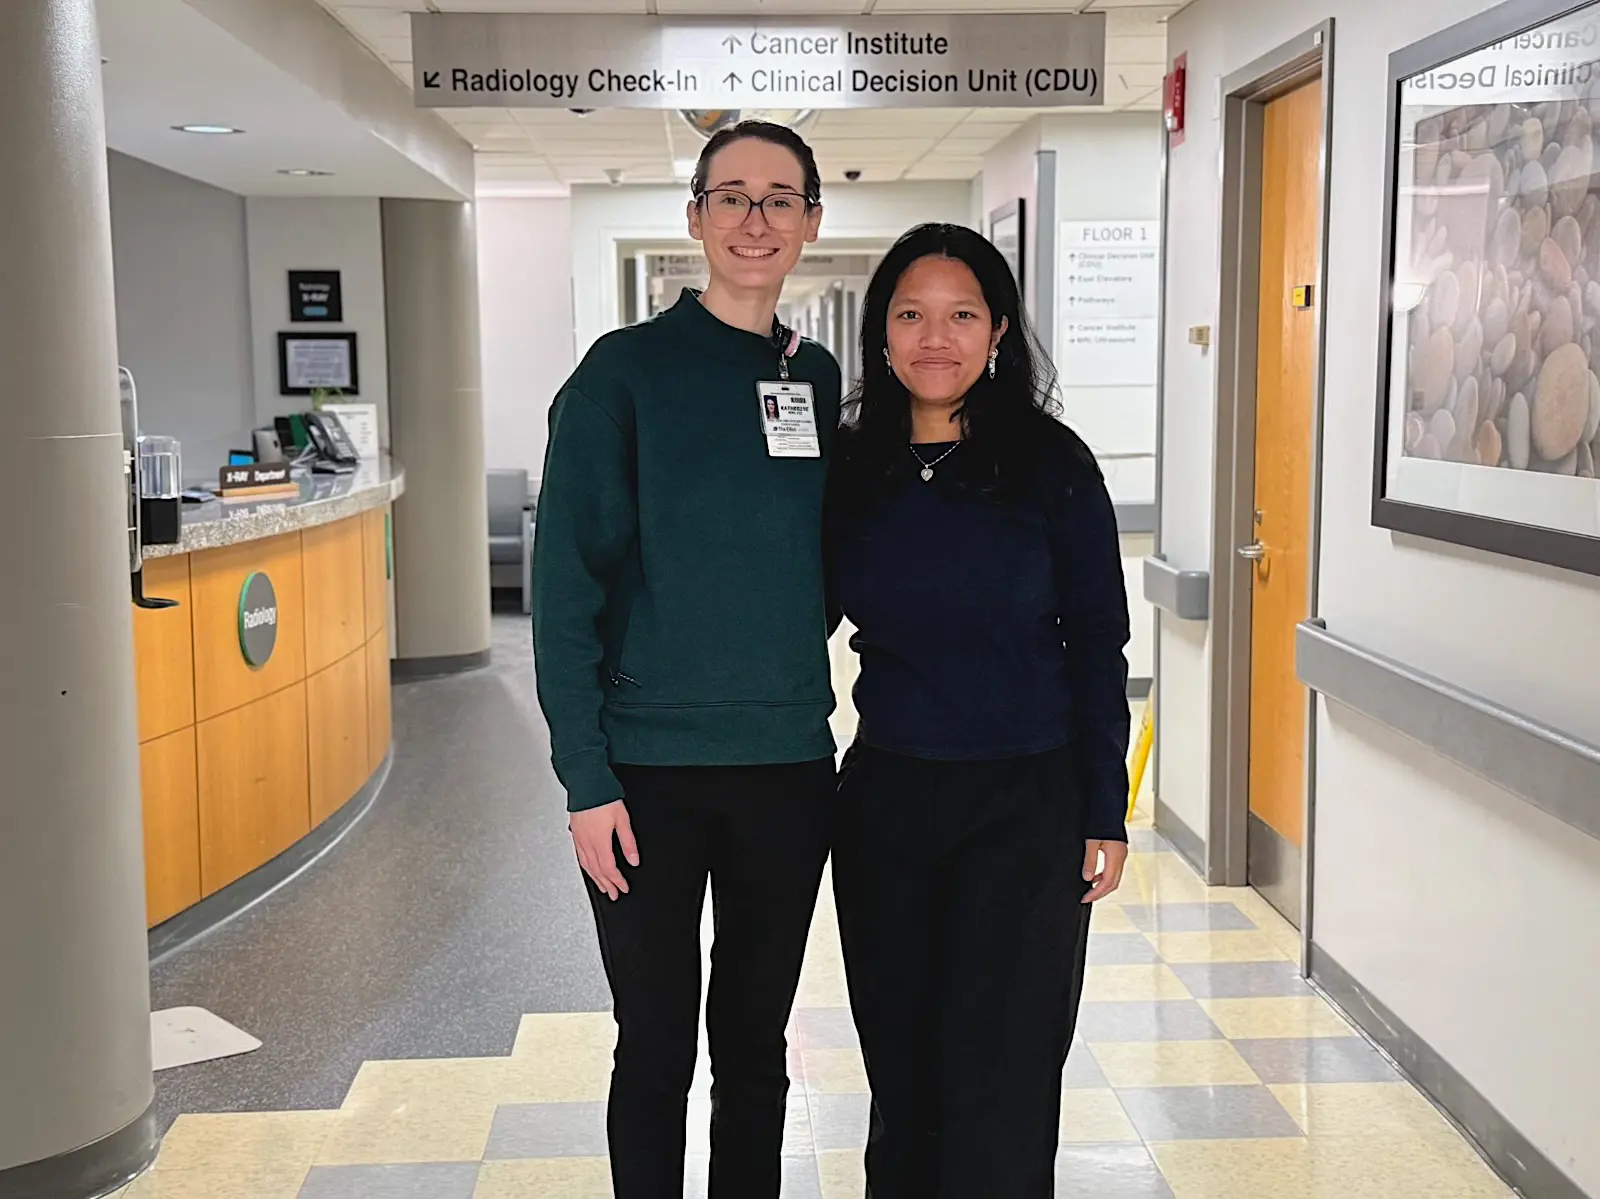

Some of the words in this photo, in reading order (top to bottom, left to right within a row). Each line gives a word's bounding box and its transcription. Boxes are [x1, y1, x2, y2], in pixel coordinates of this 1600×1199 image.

[751, 32, 839, 54] Cancer
[847, 32, 948, 54] Institute
[452, 69, 578, 97] Radiology
[588, 69, 697, 92] Check-In
[751, 69, 842, 92] Clinical
[852, 69, 958, 92] Decision
[967, 69, 1017, 92] Unit
[1025, 68, 1098, 97] (CDU)
[1082, 227, 1133, 241] FLOOR
[1140, 227, 1148, 241] 1
[244, 606, 276, 630] Radiology
